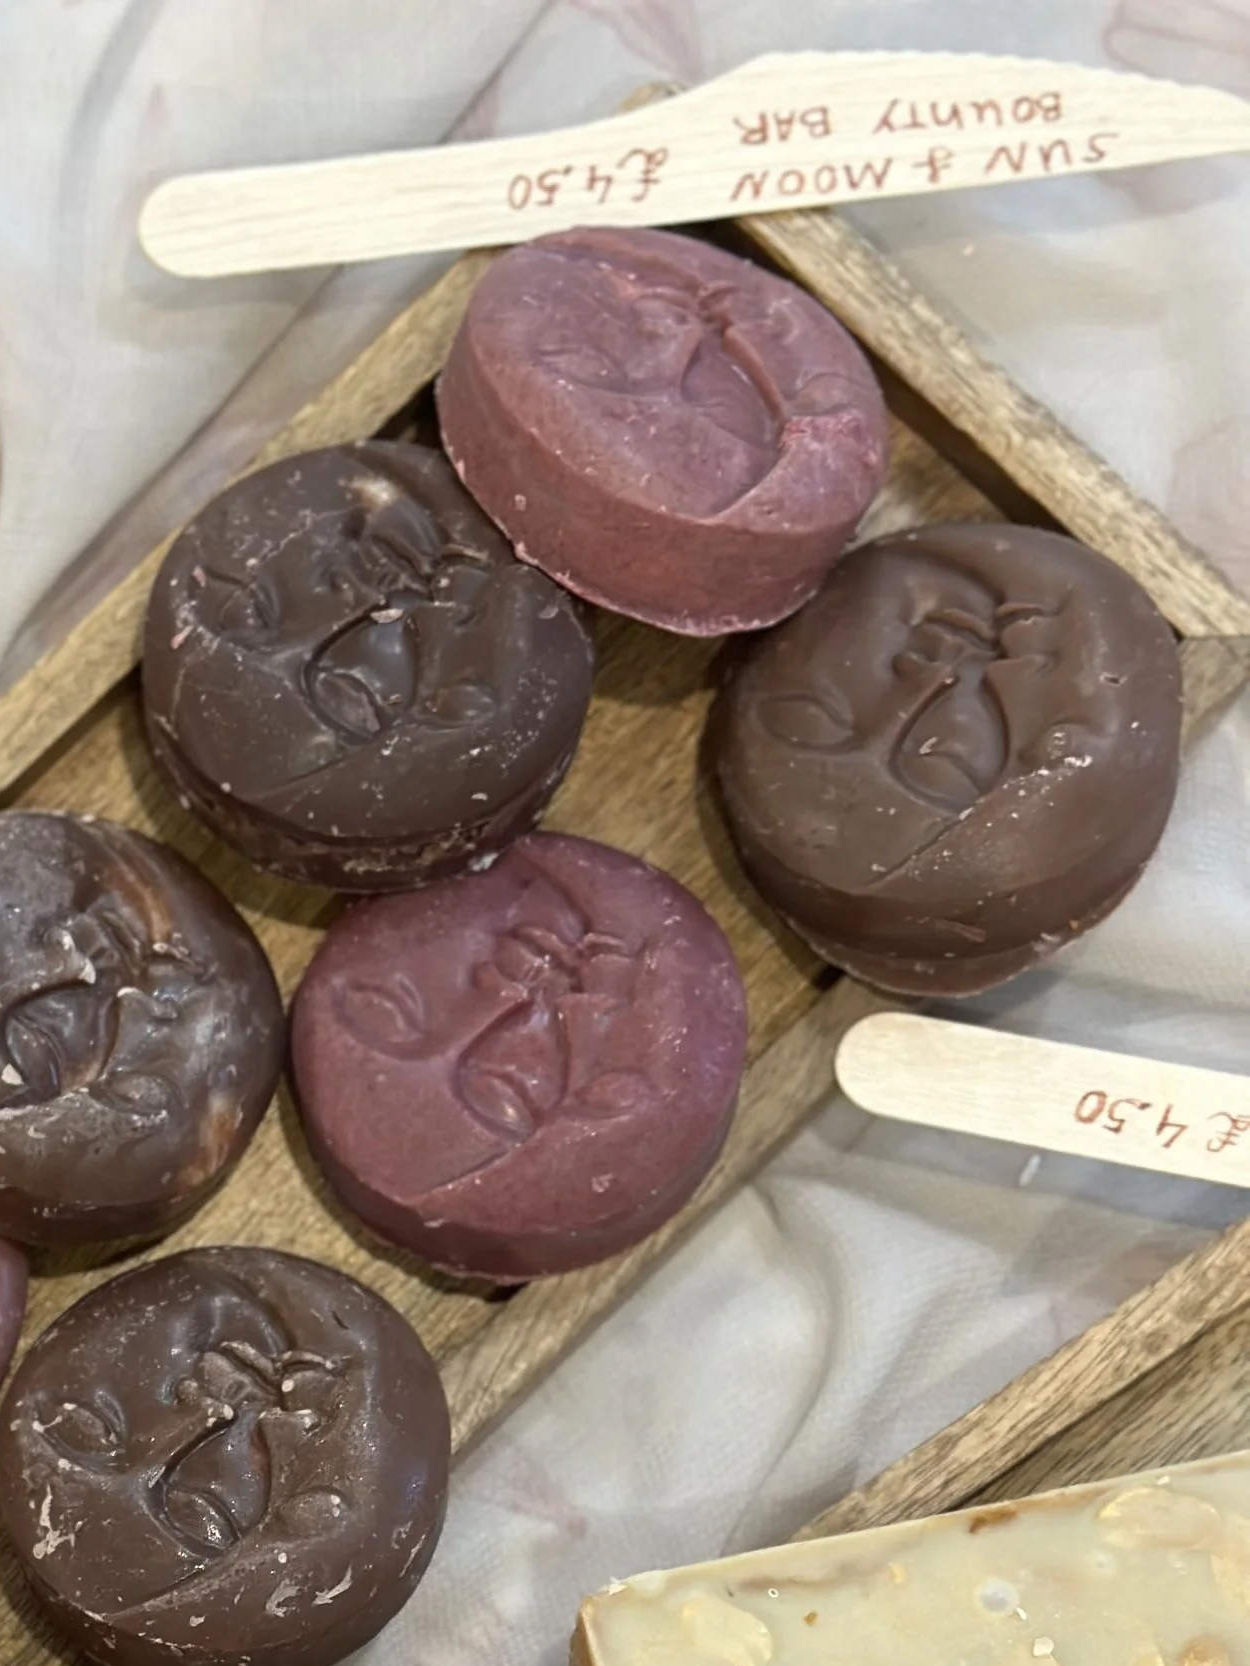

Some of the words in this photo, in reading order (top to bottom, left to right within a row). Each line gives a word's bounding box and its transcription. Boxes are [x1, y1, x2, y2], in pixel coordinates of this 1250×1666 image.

[734, 106, 831, 144] BAR
[985, 133, 1119, 175] SUN
[731, 157, 892, 202] MOON
